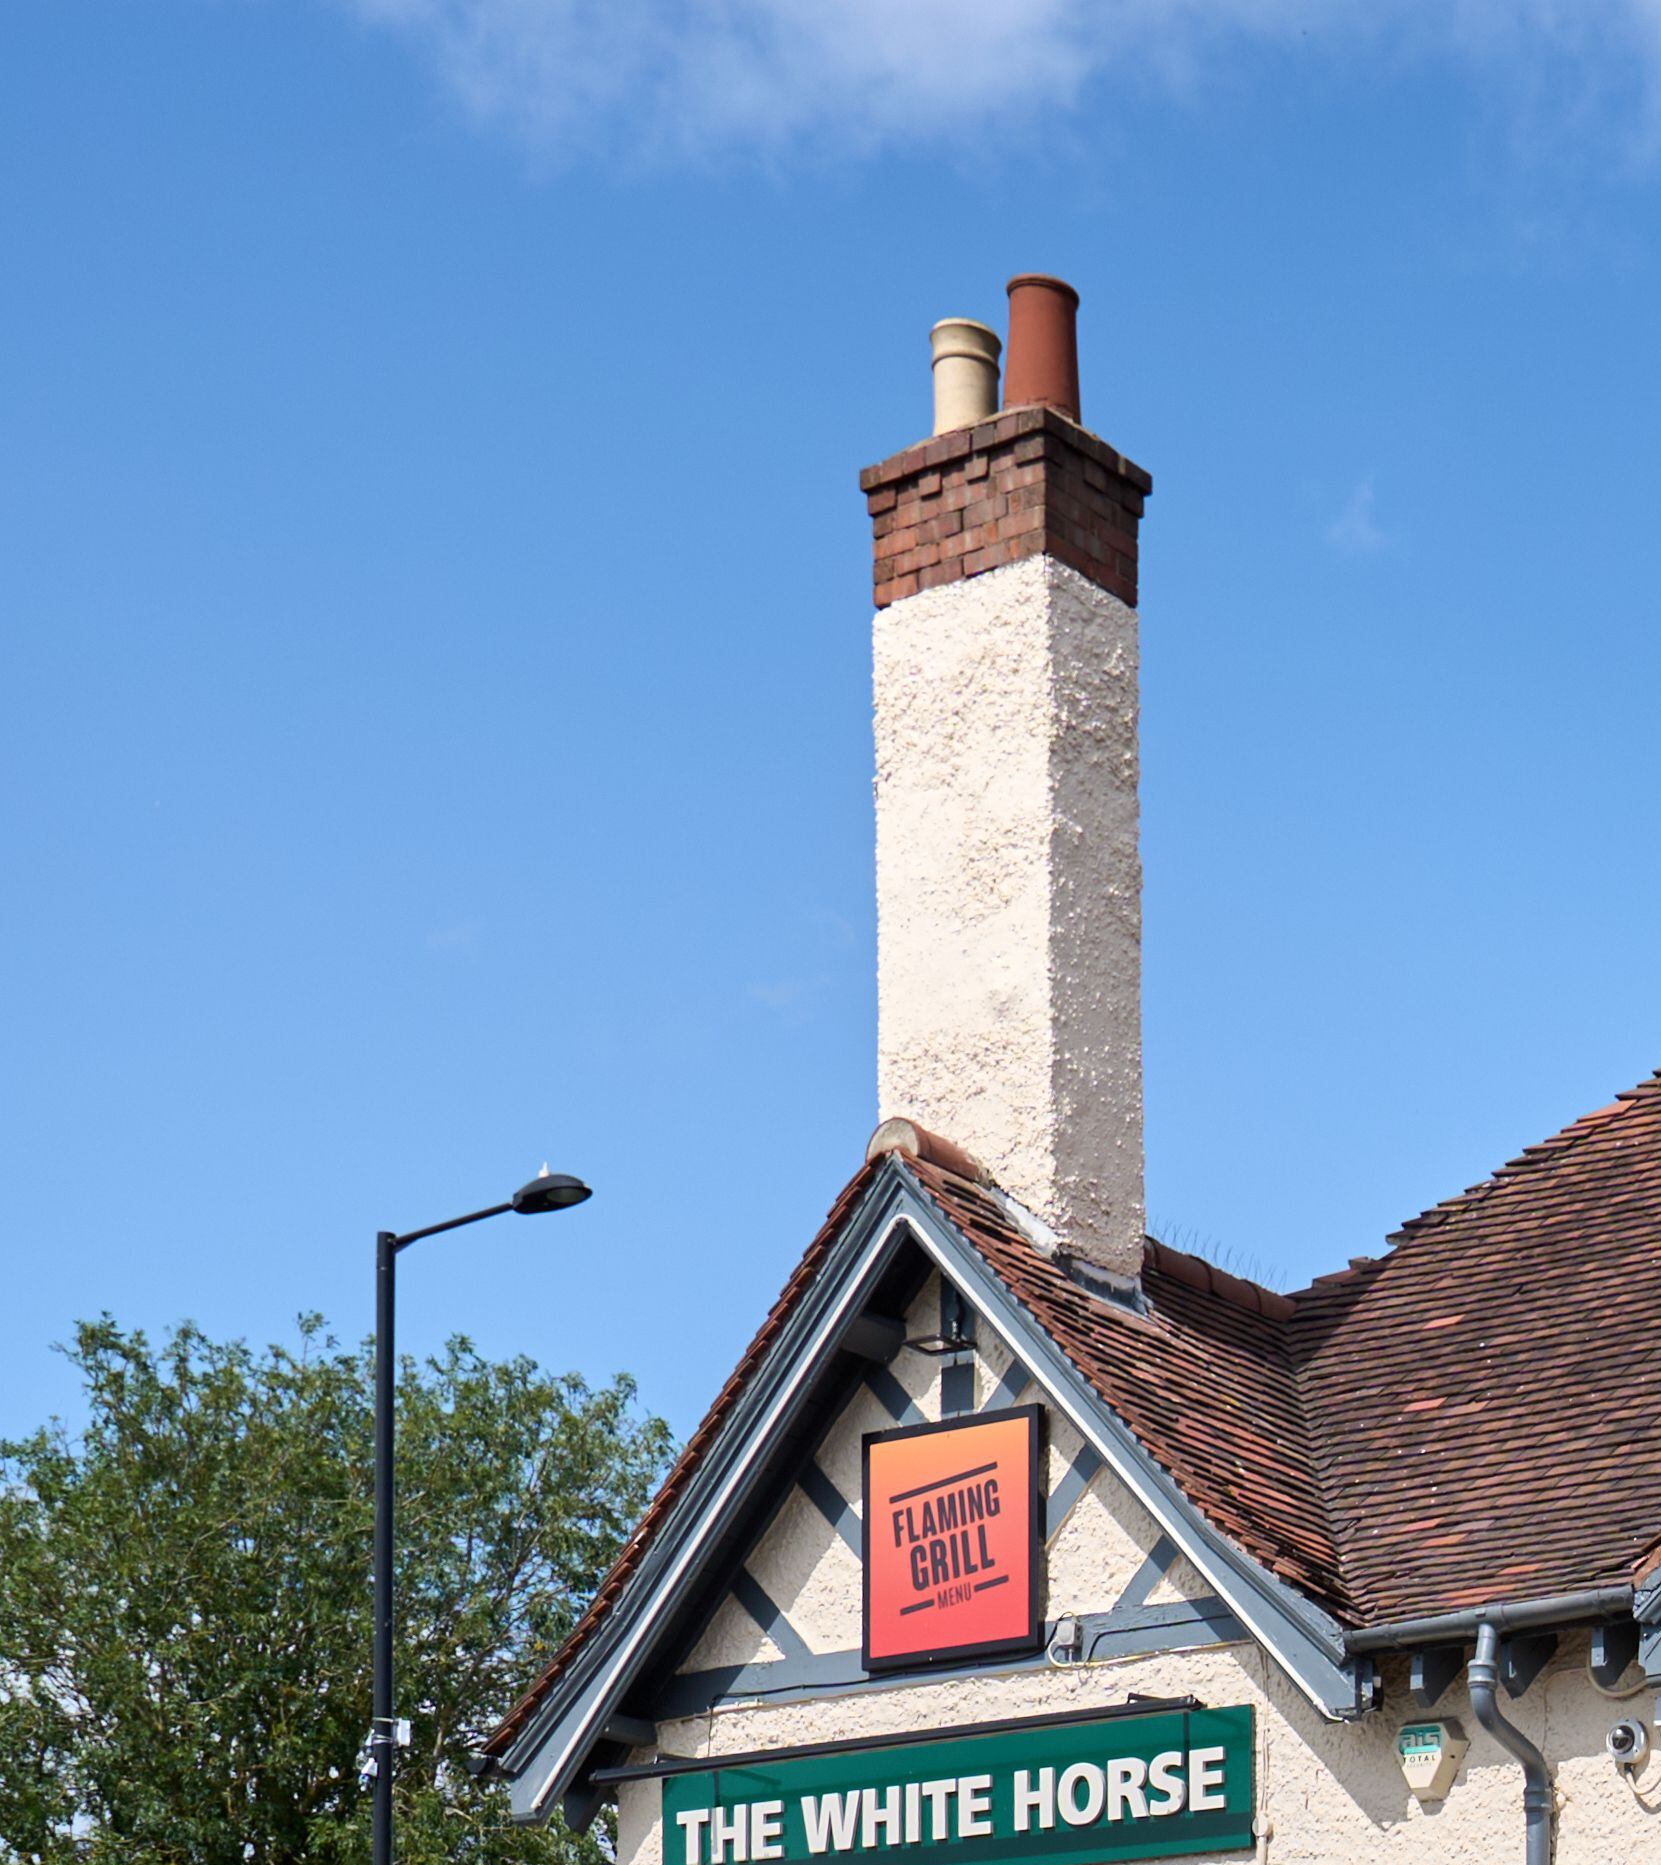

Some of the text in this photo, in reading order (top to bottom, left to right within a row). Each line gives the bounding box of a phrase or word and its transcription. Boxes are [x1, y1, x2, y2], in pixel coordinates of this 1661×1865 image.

[891, 1478, 1001, 1549] FLAMING
[910, 1524, 996, 1592] GRILL
[937, 1582, 972, 1610] MENU
[801, 1773, 994, 1854] WHITE
[1013, 1745, 1227, 1832] HORSE
